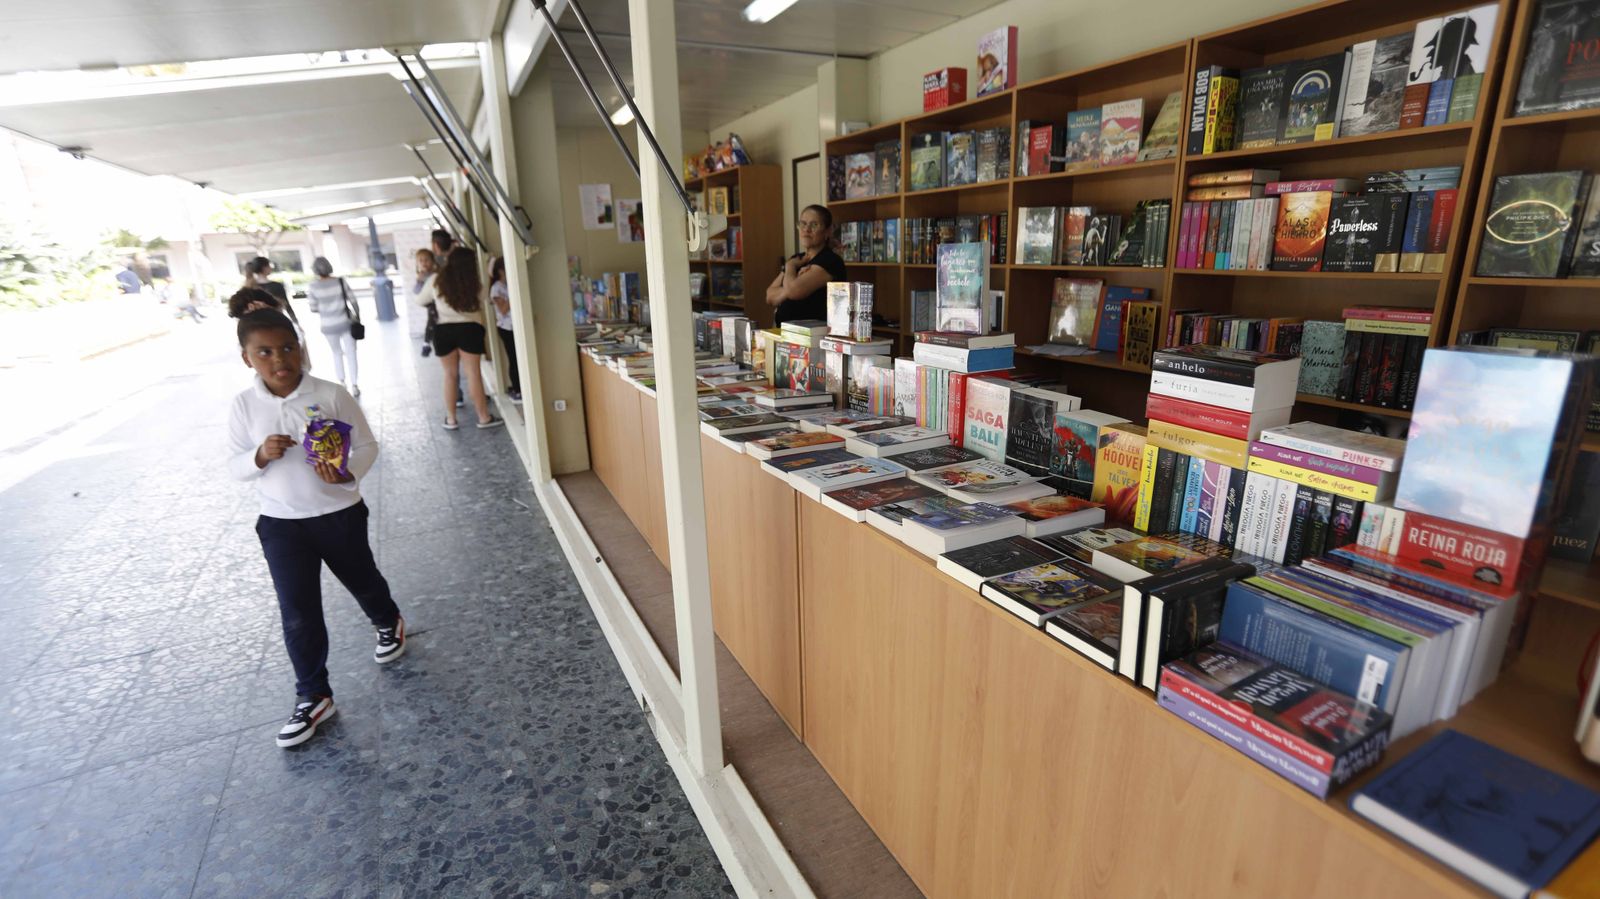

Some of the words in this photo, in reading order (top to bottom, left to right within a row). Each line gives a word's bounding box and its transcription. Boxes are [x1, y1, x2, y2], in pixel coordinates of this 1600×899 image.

[1566, 38, 1600, 65] PO
[1196, 69, 1210, 94] BOB
[1191, 95, 1206, 132] DYLAN
[1282, 218, 1310, 227] ALAS
[1329, 218, 1379, 236] Powerless
[1168, 360, 1206, 374] anhelo
[1170, 382, 1198, 393] furia
[968, 406, 1004, 430] SAGA
[970, 425, 999, 446] BALI
[1162, 431, 1196, 446] fulgor
[1342, 451, 1369, 464] PUNK
[1276, 493, 1288, 514] FUEGO
[1408, 527, 1457, 554] REINA
[1461, 541, 1507, 568] ROJA
